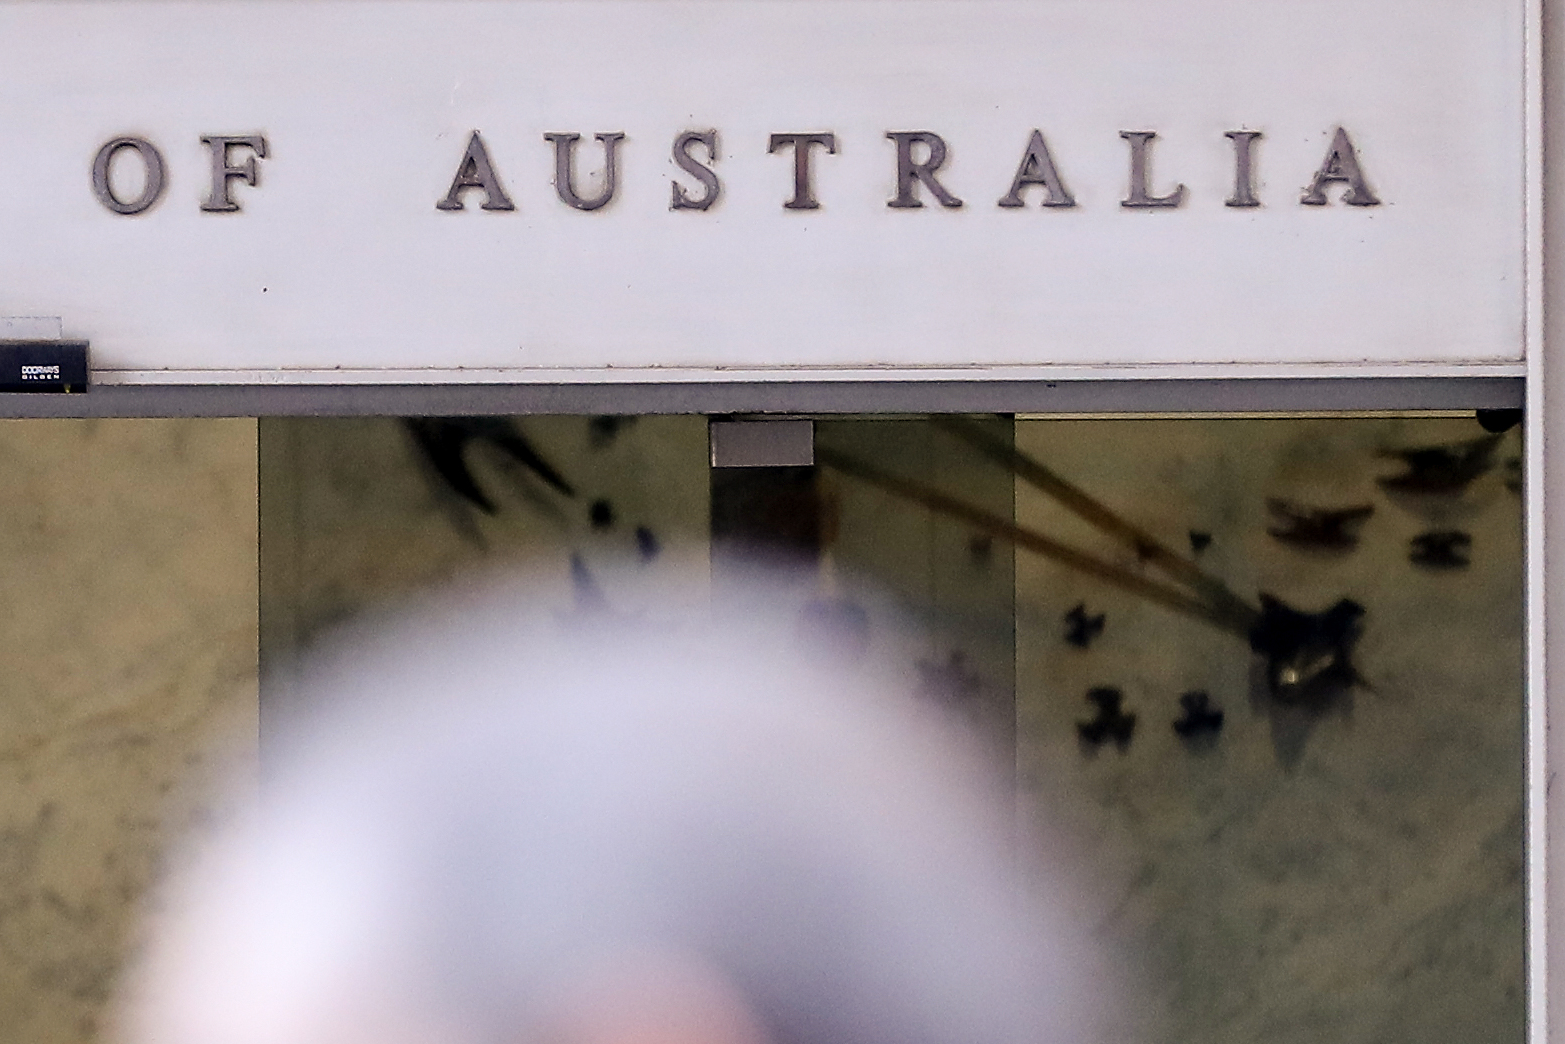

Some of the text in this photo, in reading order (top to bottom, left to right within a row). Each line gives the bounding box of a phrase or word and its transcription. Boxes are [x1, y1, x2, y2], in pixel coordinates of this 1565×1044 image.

[91, 135, 270, 215] OF
[435, 126, 1383, 212] AUSTRALIA
[21, 365, 60, 374] DOORWAYS
